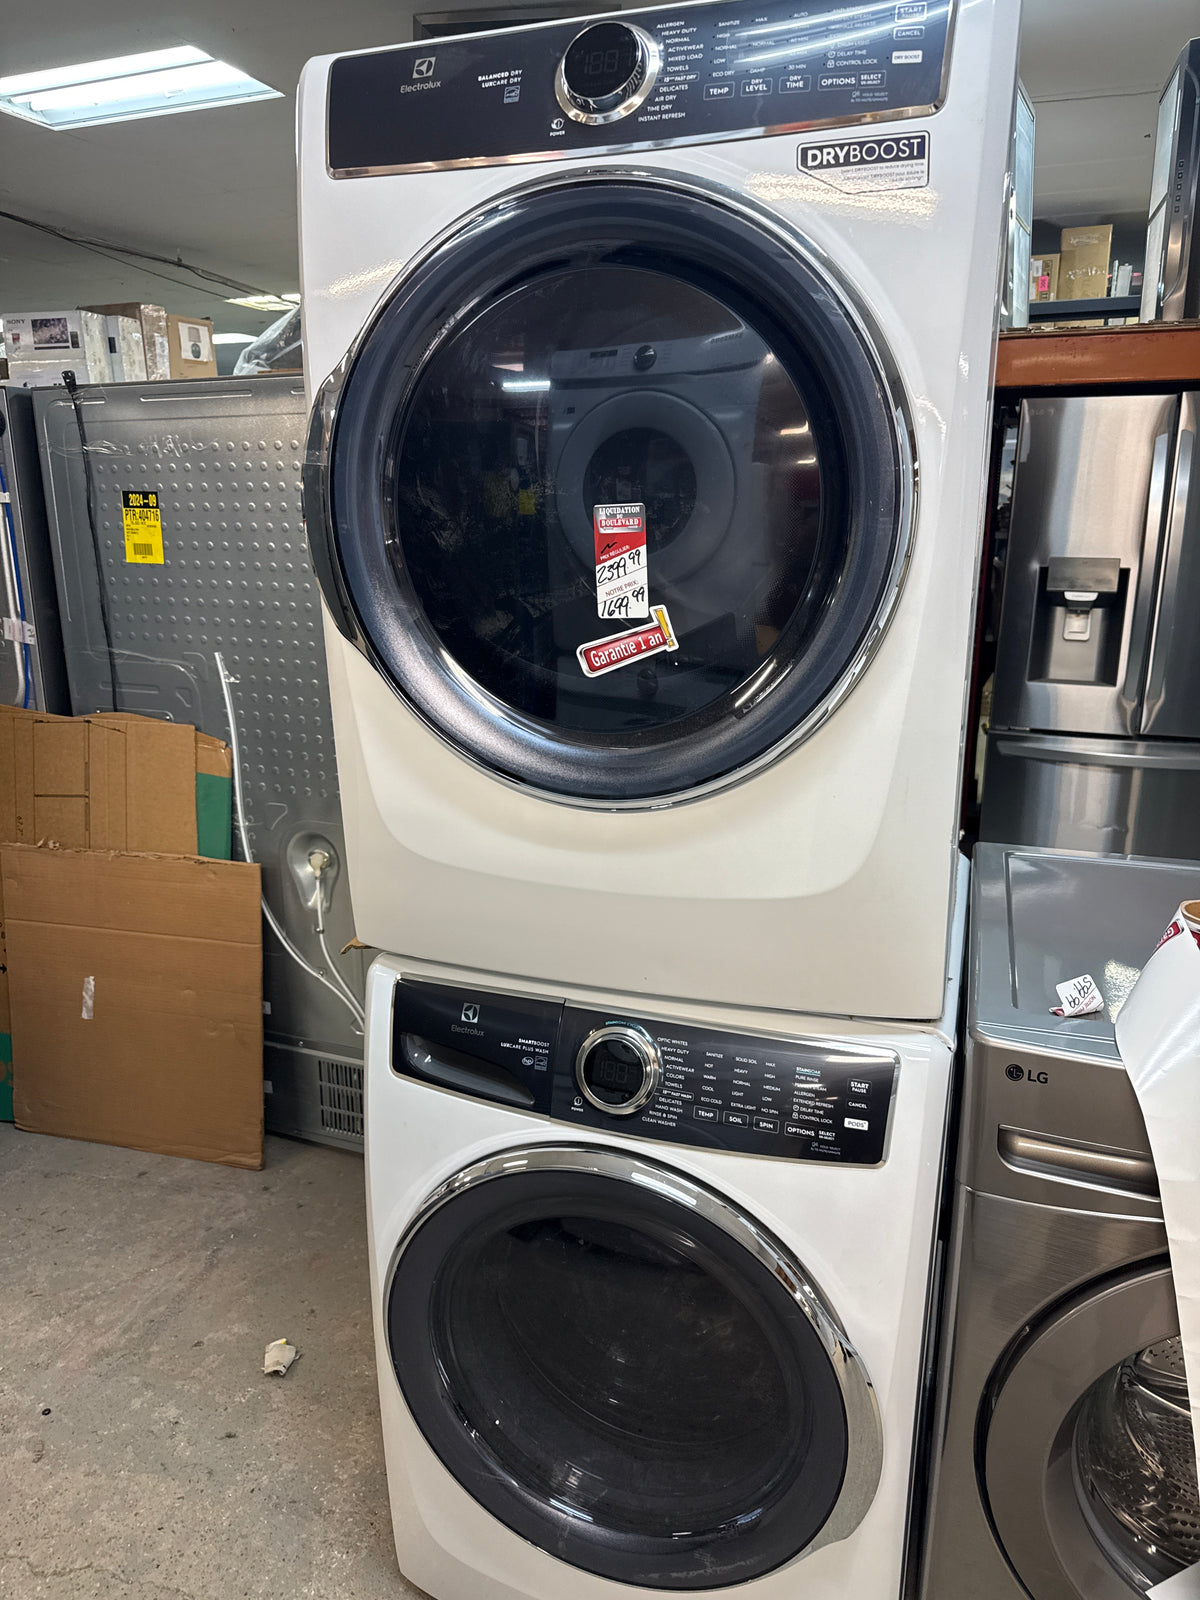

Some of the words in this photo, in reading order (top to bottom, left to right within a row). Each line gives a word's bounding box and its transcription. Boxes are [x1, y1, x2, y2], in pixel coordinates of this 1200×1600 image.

[668, 44, 704, 52] ACTIVEWEAR
[478, 71, 510, 82] BALANCED
[482, 80, 508, 88] LUXCARE
[786, 81, 804, 89] TIME
[821, 77, 856, 86] OPTIONS
[400, 80, 442, 94] Electrolux
[660, 84, 688, 92] DELICATES
[709, 86, 730, 96] TEMP
[745, 84, 768, 92] LEVEL
[638, 114, 662, 122] INSTANT
[807, 138, 922, 167] DRYBOOST
[599, 506, 640, 516] LIQUIDATION
[601, 518, 639, 527] BOULEVARD
[605, 584, 624, 598] NOTRE
[590, 641, 638, 668] Garantie
[638, 638, 646, 650] 1
[450, 1024, 485, 1036] Electrolux
[500, 1042, 521, 1050] LUXCARE
[518, 1038, 550, 1048] SMARTBOOST
[672, 1038, 688, 1046] WHITES
[665, 1064, 695, 1073] ACTIVEWEAR
[666, 1072, 685, 1080] COLORS
[1027, 1070, 1049, 1084] LG
[664, 1081, 683, 1089] TOWELS
[732, 1079, 751, 1087] NORMAL
[850, 1081, 870, 1090] START
[794, 1090, 816, 1098] ALLERGEN
[658, 1096, 682, 1106] DELICATES
[793, 1098, 816, 1106] EXTENDED
[816, 1101, 834, 1109] REFRESH
[848, 1102, 868, 1110] CANCEL
[698, 1110, 714, 1118] TEMP
[800, 1114, 820, 1122] CONTROL
[642, 1116, 658, 1124] CLEAN
[658, 1119, 676, 1127] WASHER
[728, 1115, 743, 1124] SOIL
[760, 1121, 774, 1129] SPIN
[787, 1126, 815, 1136] OPTIONS
